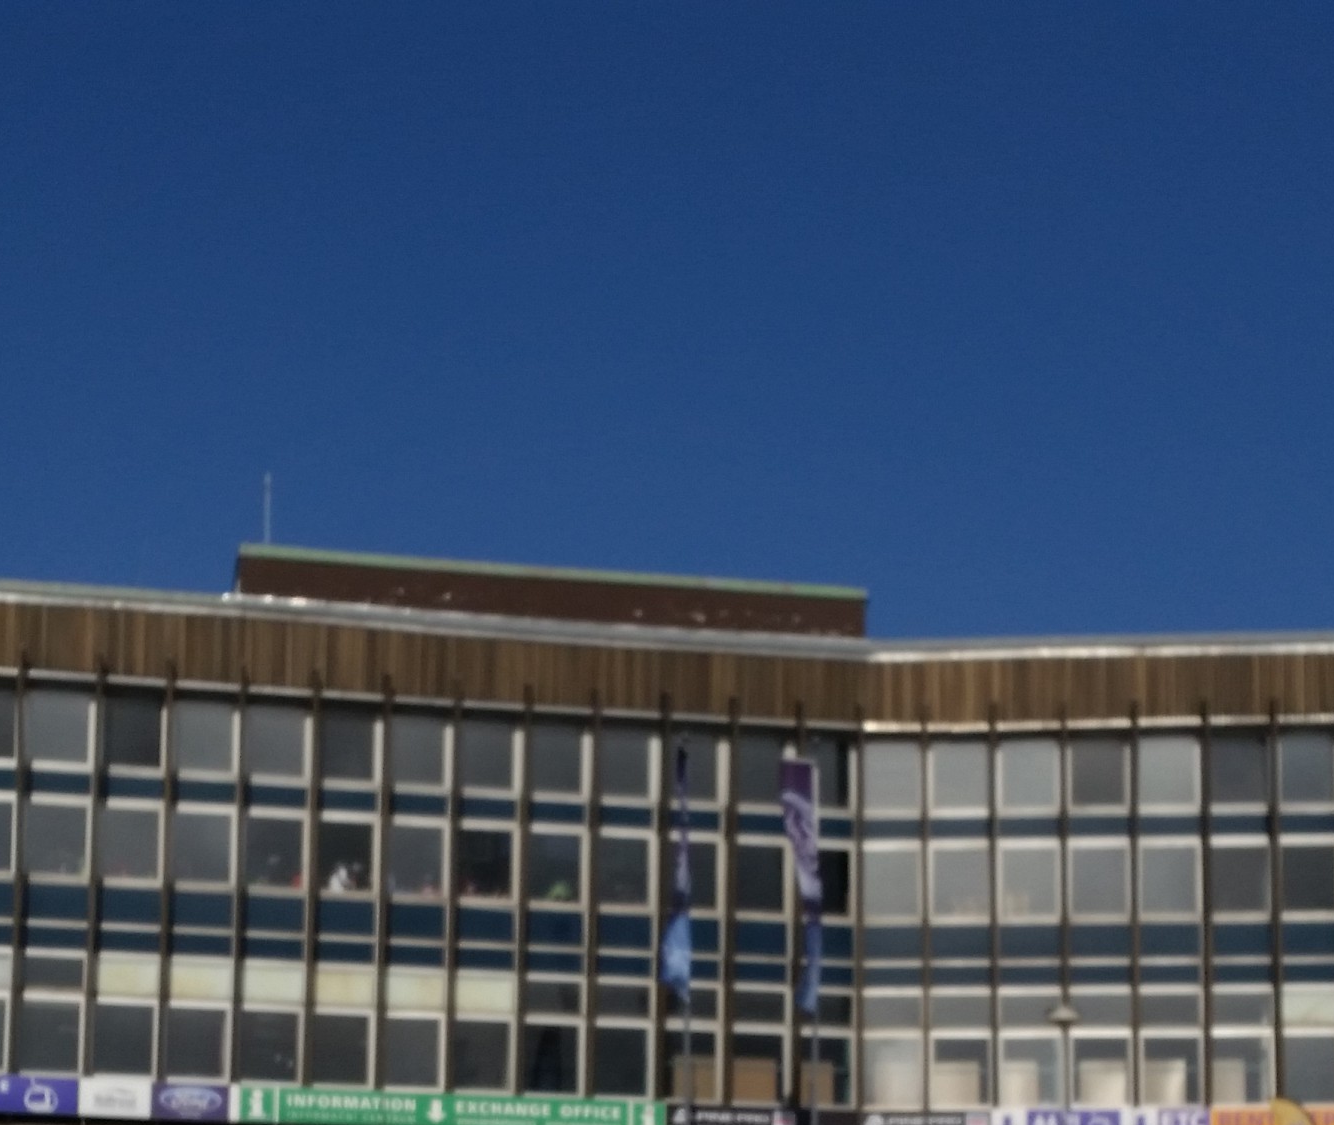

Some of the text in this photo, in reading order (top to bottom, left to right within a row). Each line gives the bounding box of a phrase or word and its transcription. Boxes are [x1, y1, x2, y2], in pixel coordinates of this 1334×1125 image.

[285, 1093, 418, 1112] INFORMATION
[454, 1100, 622, 1121] EXCHANGE OFFICE
